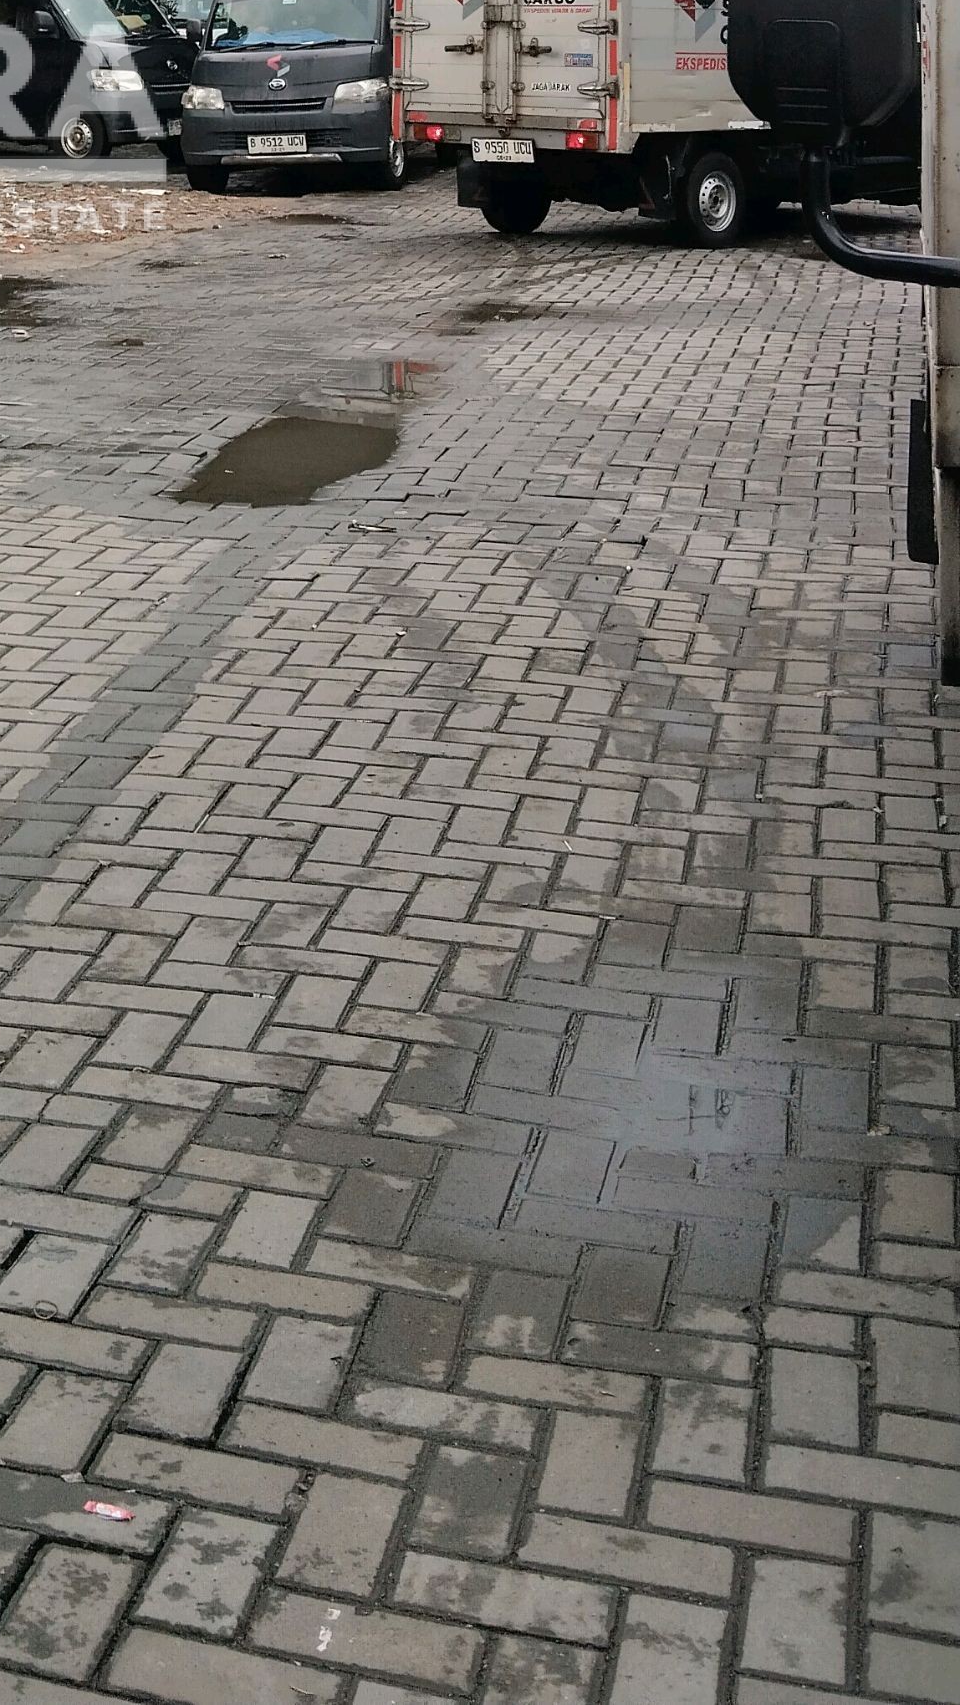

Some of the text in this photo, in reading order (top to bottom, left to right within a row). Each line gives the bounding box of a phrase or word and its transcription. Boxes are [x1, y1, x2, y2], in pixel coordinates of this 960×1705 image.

[675, 57, 727, 70] EKSPEDIS
[250, 137, 256, 148] B
[260, 137, 284, 147] 9512
[484, 141, 509, 154] 9550
